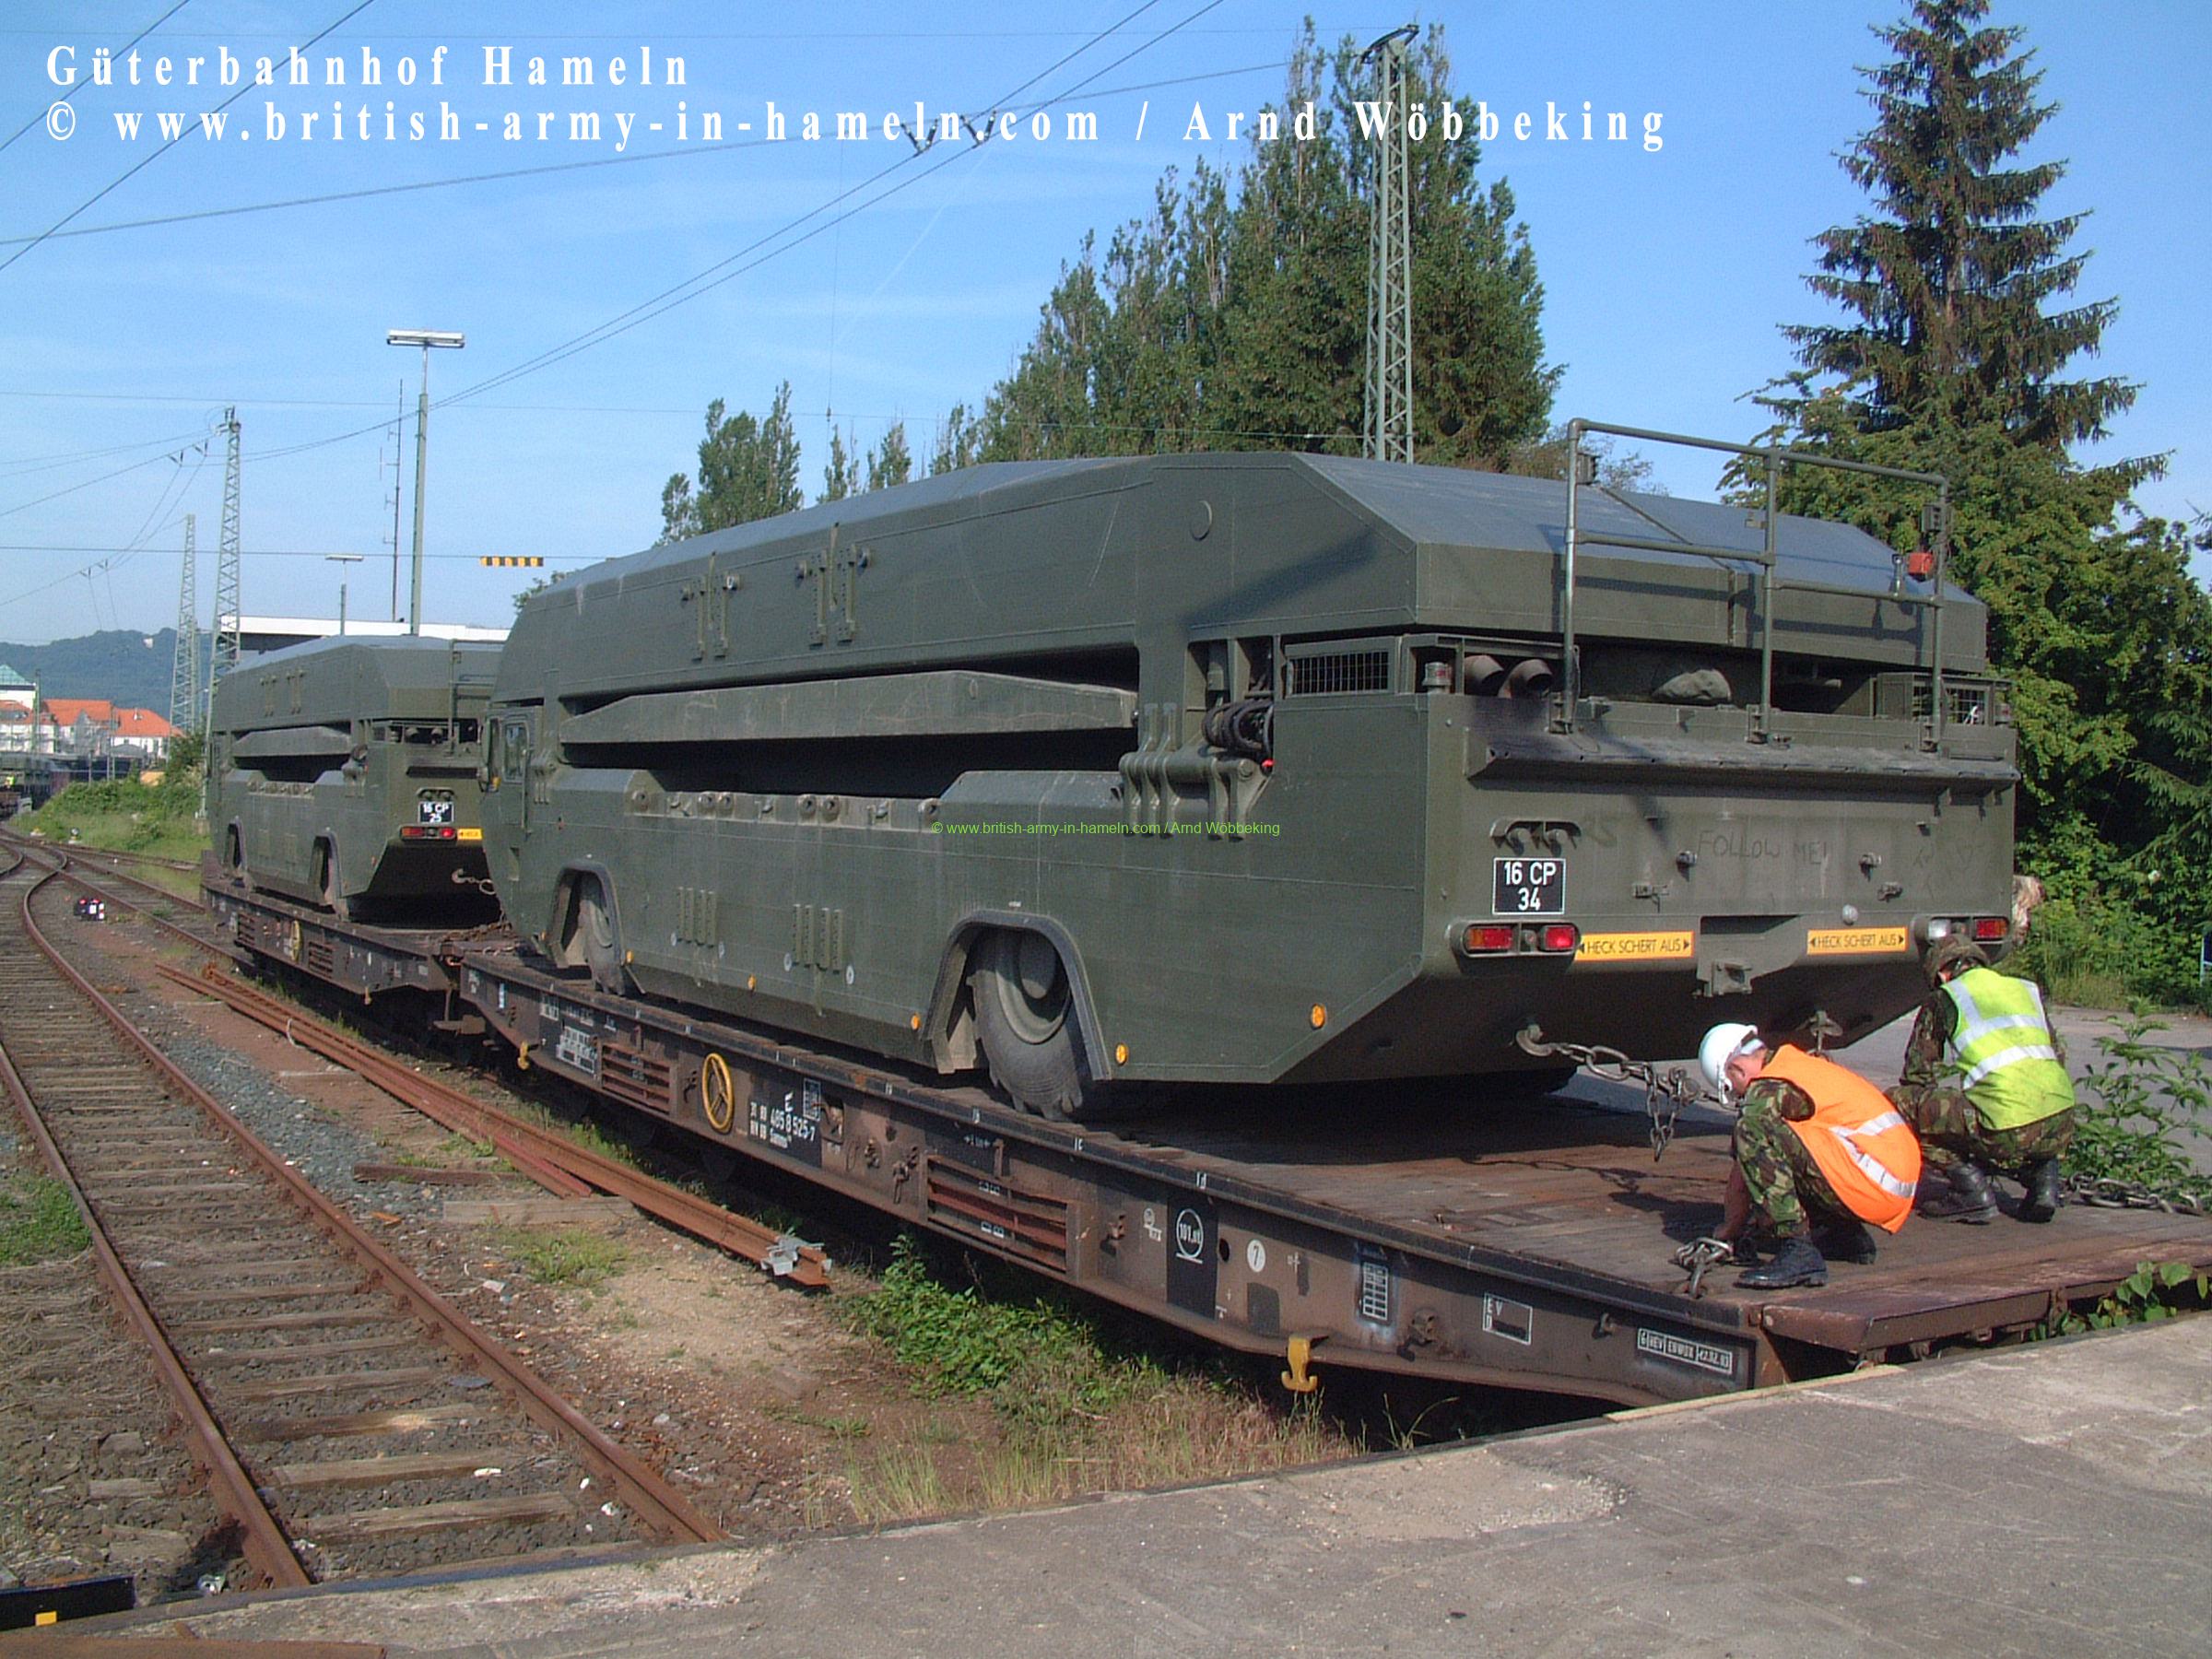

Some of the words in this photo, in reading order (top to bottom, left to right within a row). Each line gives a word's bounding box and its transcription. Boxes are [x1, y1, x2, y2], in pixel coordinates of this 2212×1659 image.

[1698, 830, 1781, 859] FOLLOW
[1503, 861, 1523, 885] 16
[1530, 862, 1557, 886] CP
[1517, 887, 1541, 912] 34
[1586, 939, 1617, 955] HECK
[1618, 938, 1657, 954] SCHERT
[1659, 937, 1682, 953] AUS
[1817, 935, 1842, 948] HECK
[1844, 934, 1877, 948] SCHERT
[1879, 933, 1897, 947] AUS
